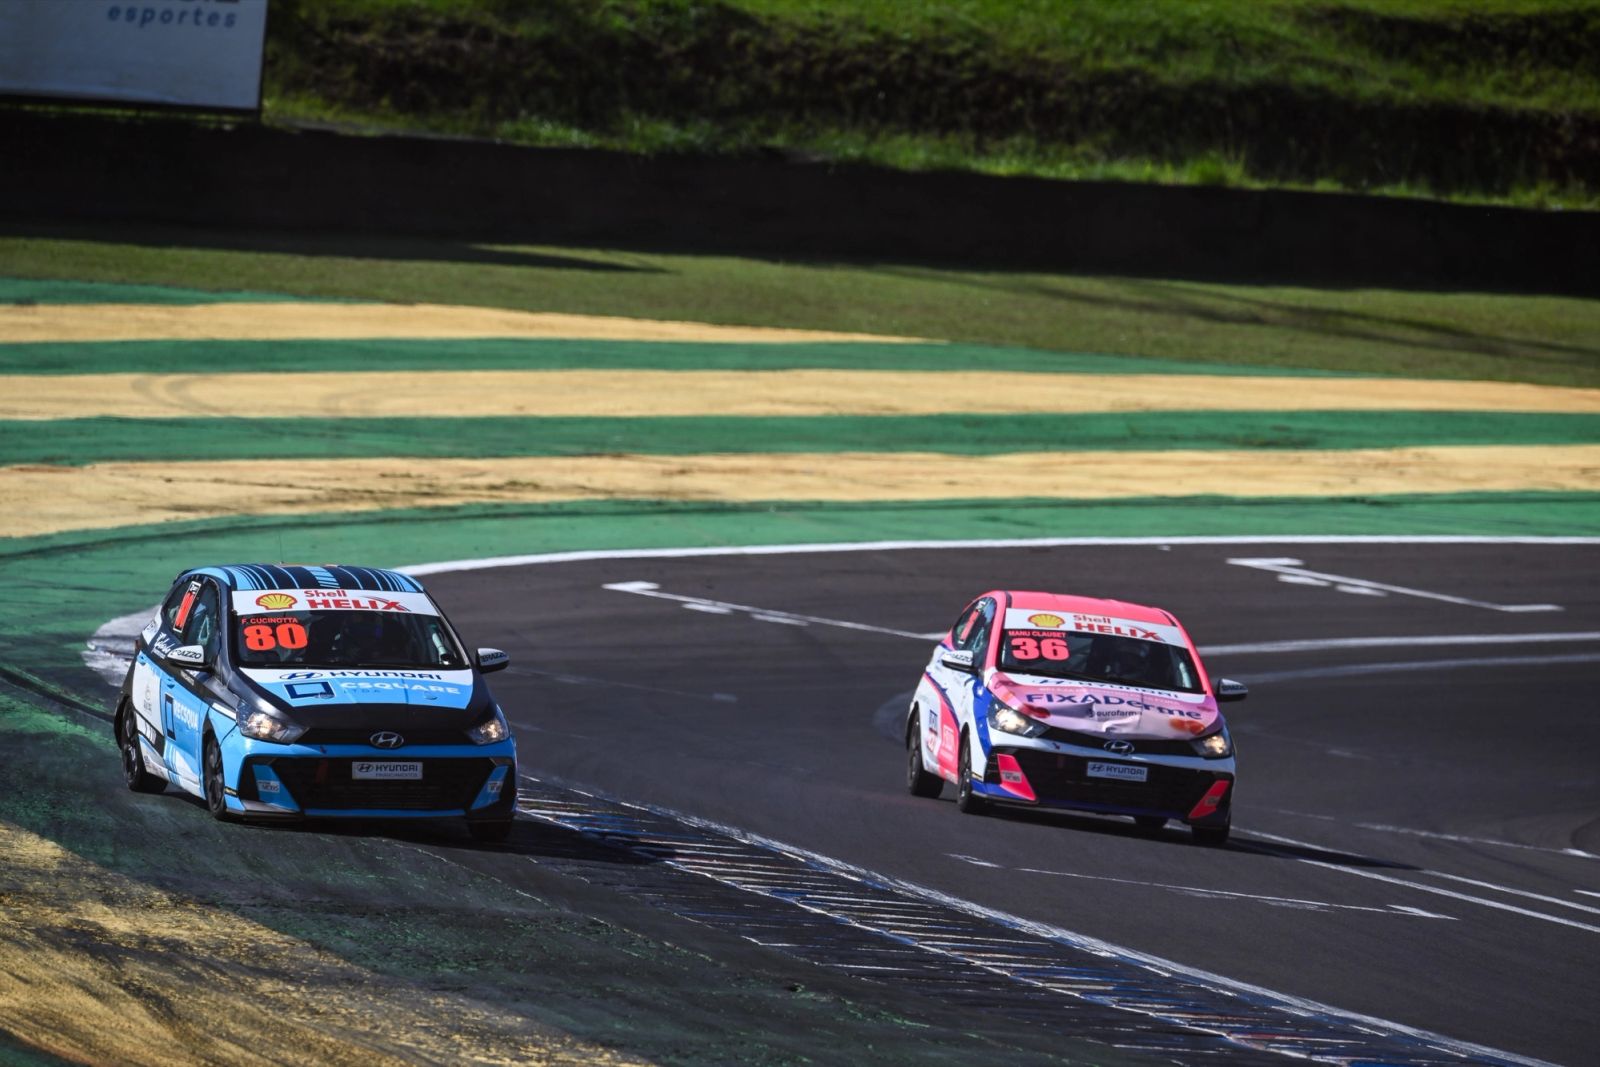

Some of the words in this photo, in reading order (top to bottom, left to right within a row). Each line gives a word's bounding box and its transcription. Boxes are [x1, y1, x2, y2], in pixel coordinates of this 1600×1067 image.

[107, 4, 237, 28] esportes
[304, 589, 348, 598] Shell
[307, 598, 409, 611] HELIX
[1073, 614, 1112, 625] Shell
[243, 624, 308, 651] 80
[1074, 622, 1167, 642] HELIX
[1011, 637, 1071, 661] 36
[329, 671, 442, 681] HYUNDAI
[339, 682, 461, 695] CSQUARE
[1026, 693, 1203, 720] FIXADerme
[375, 764, 418, 772] HYUNDAI
[1106, 765, 1145, 776] HYUNDAI
